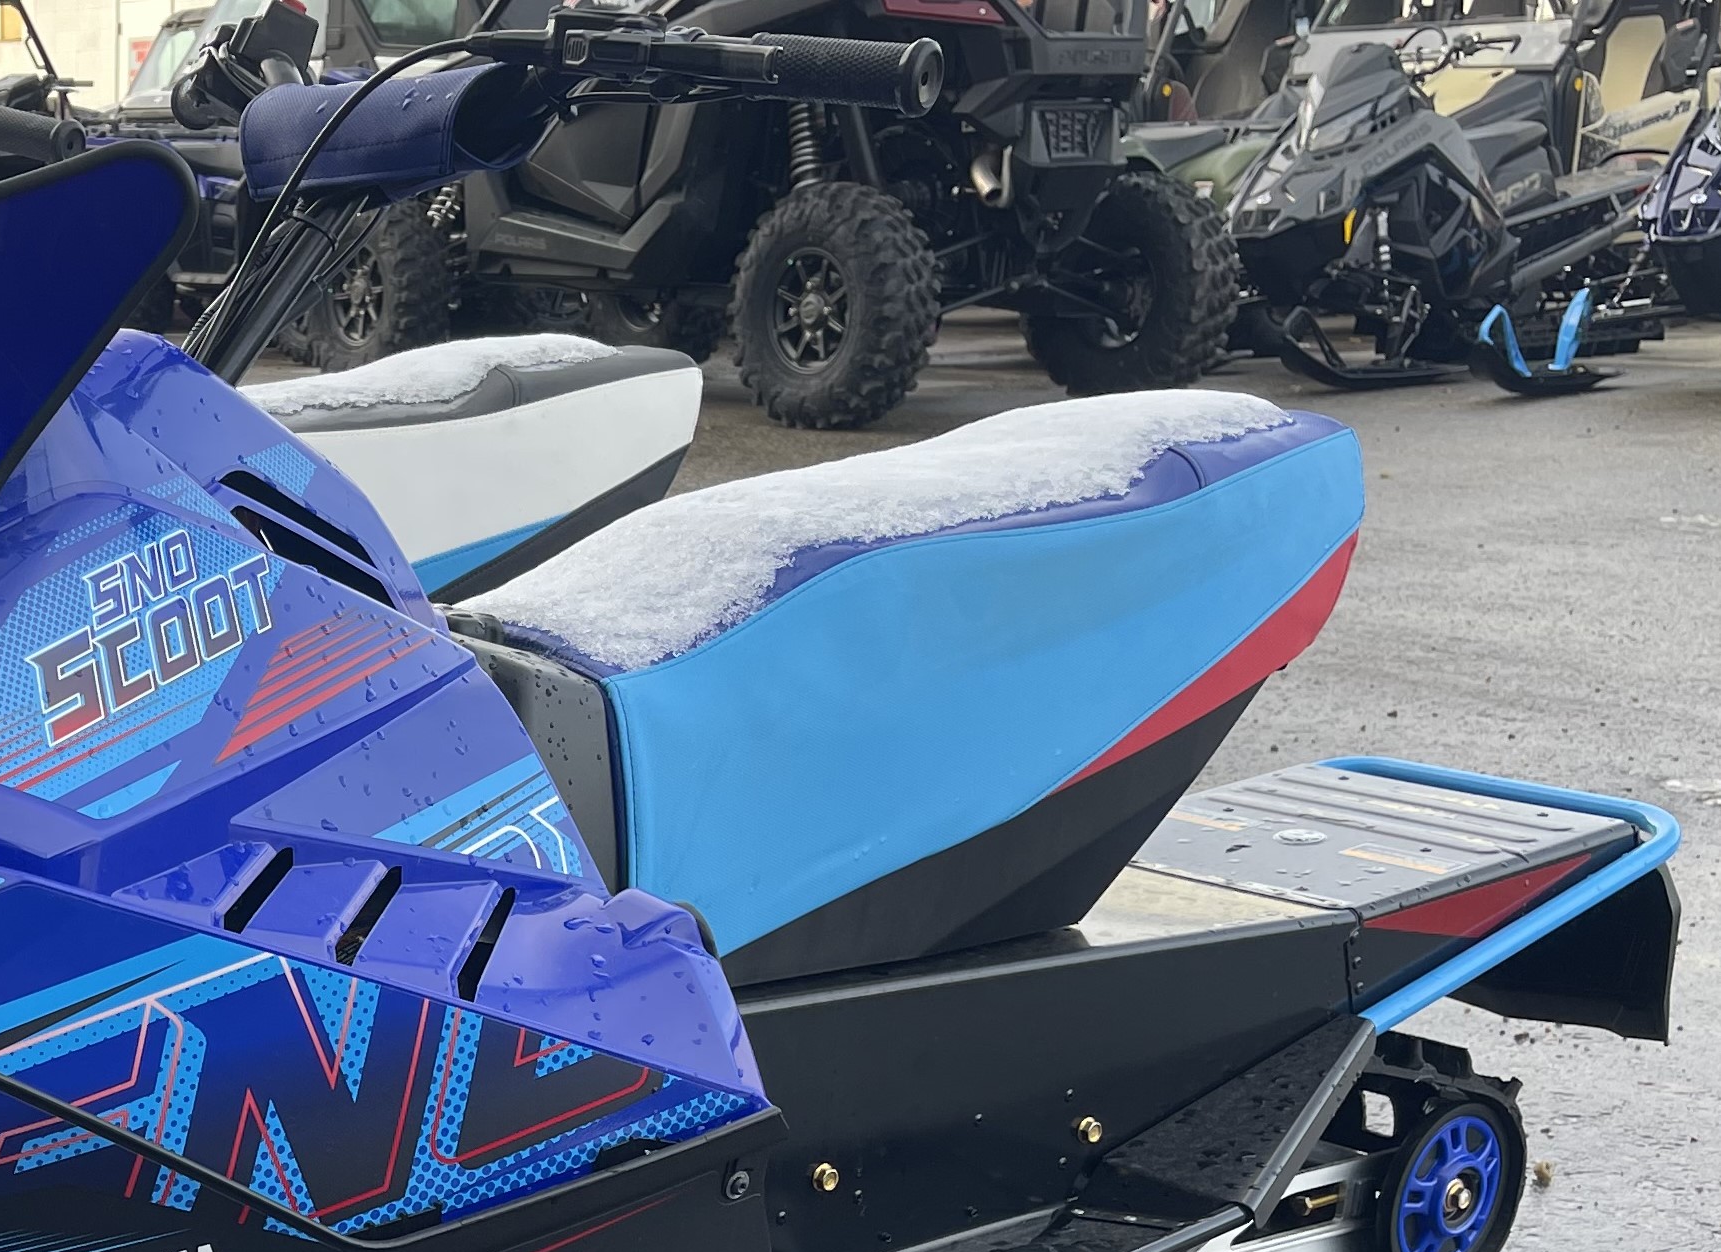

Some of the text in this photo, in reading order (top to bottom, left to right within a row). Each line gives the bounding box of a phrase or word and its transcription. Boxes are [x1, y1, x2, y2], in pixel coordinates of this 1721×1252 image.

[1361, 120, 1433, 174] POLARIS
[82, 529, 198, 632] SNO
[24, 552, 273, 748] SCOOT
